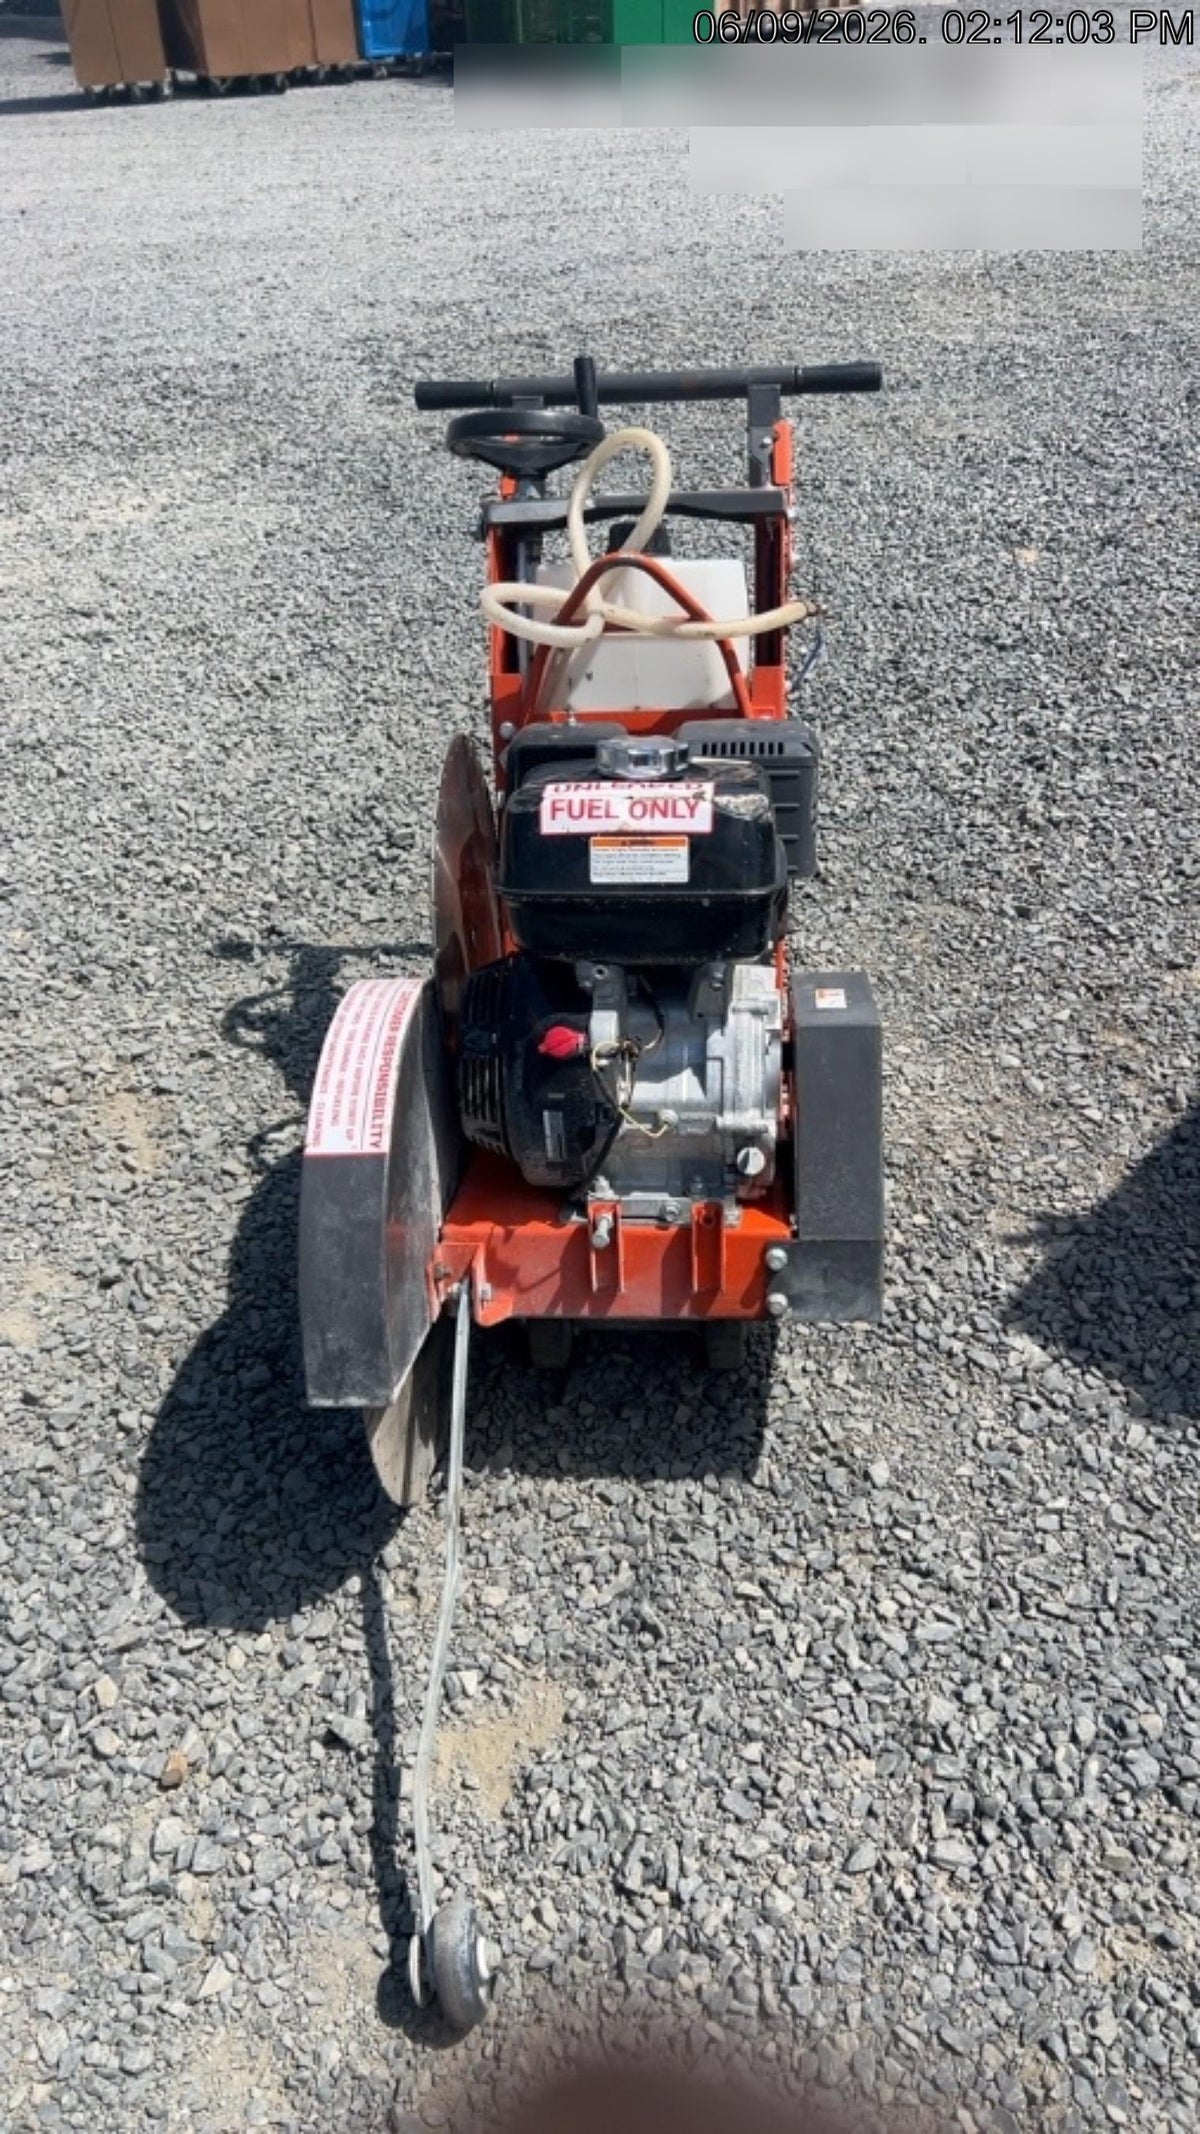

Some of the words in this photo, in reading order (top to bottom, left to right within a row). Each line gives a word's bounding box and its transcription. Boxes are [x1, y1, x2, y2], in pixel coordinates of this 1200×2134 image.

[551, 799, 619, 821] FUEL
[627, 799, 699, 820] ONLY
[369, 1035, 398, 1149] RESPONSIBILITY
